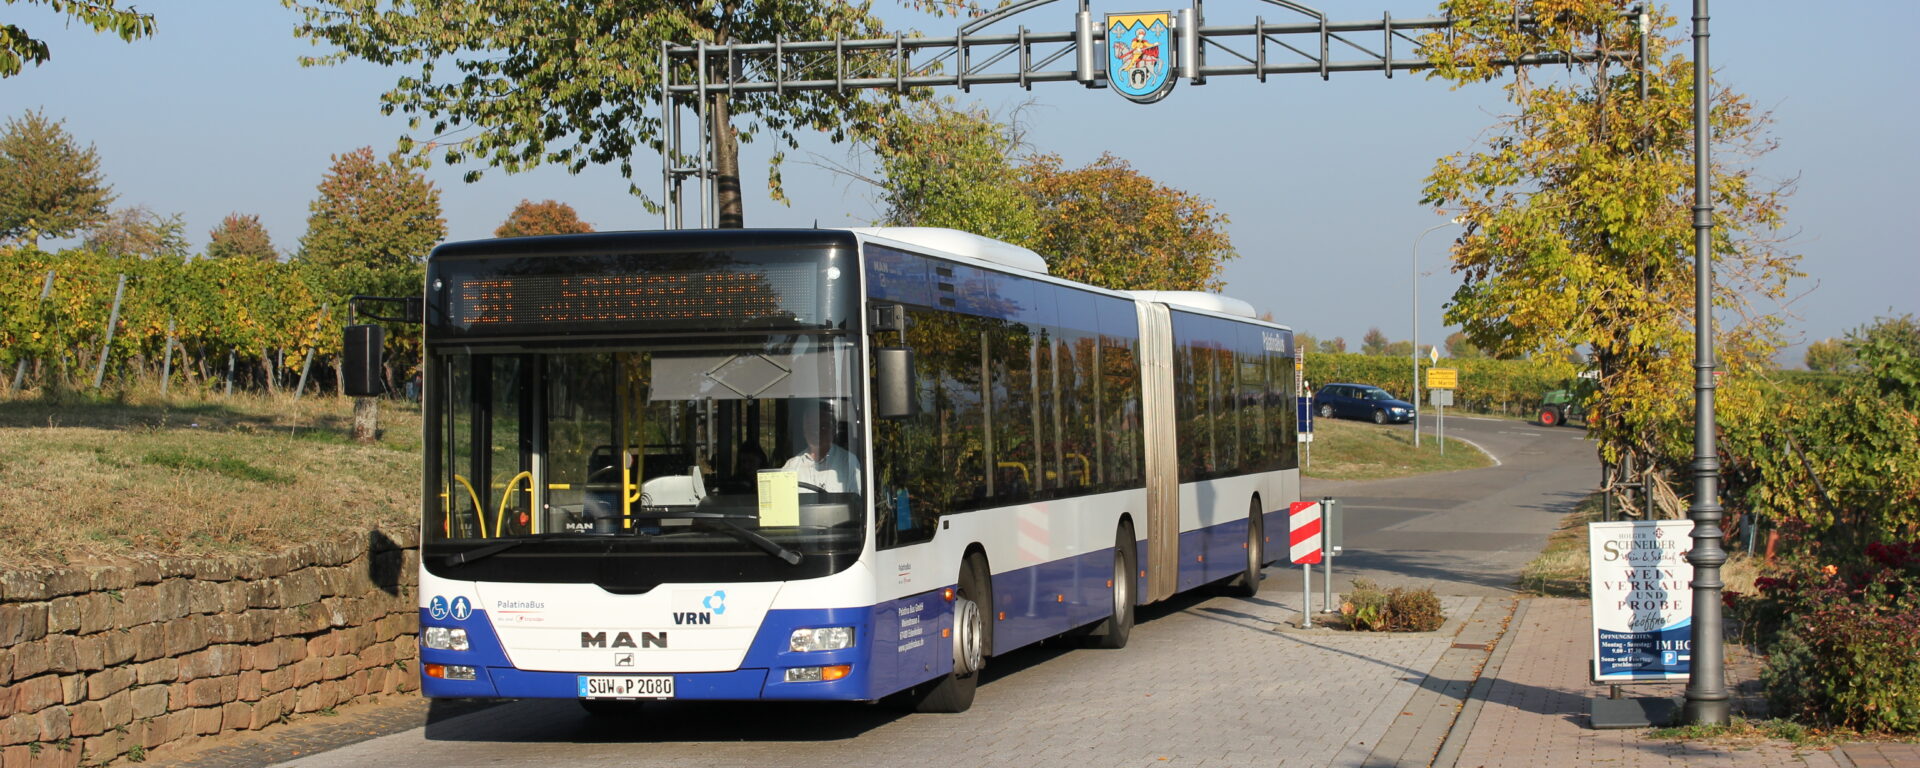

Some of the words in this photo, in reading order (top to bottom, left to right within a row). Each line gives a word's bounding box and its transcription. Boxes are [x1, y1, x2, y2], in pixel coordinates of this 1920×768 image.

[463, 280, 512, 322] 501
[1603, 540, 1675, 562] SCHNEIDER
[1624, 569, 1674, 580] WEIN
[1636, 592, 1663, 600] UND
[497, 600, 545, 609] PalatinaBus
[1617, 600, 1683, 611] PROBE
[673, 612, 711, 625] VRN
[1628, 612, 1672, 632] Geöffnet
[581, 631, 668, 648] MAN
[1656, 640, 1671, 650] IM
[1676, 640, 1691, 650] HO
[589, 678, 615, 694] SÜW
[626, 679, 634, 694] P
[637, 678, 672, 694] 2080
